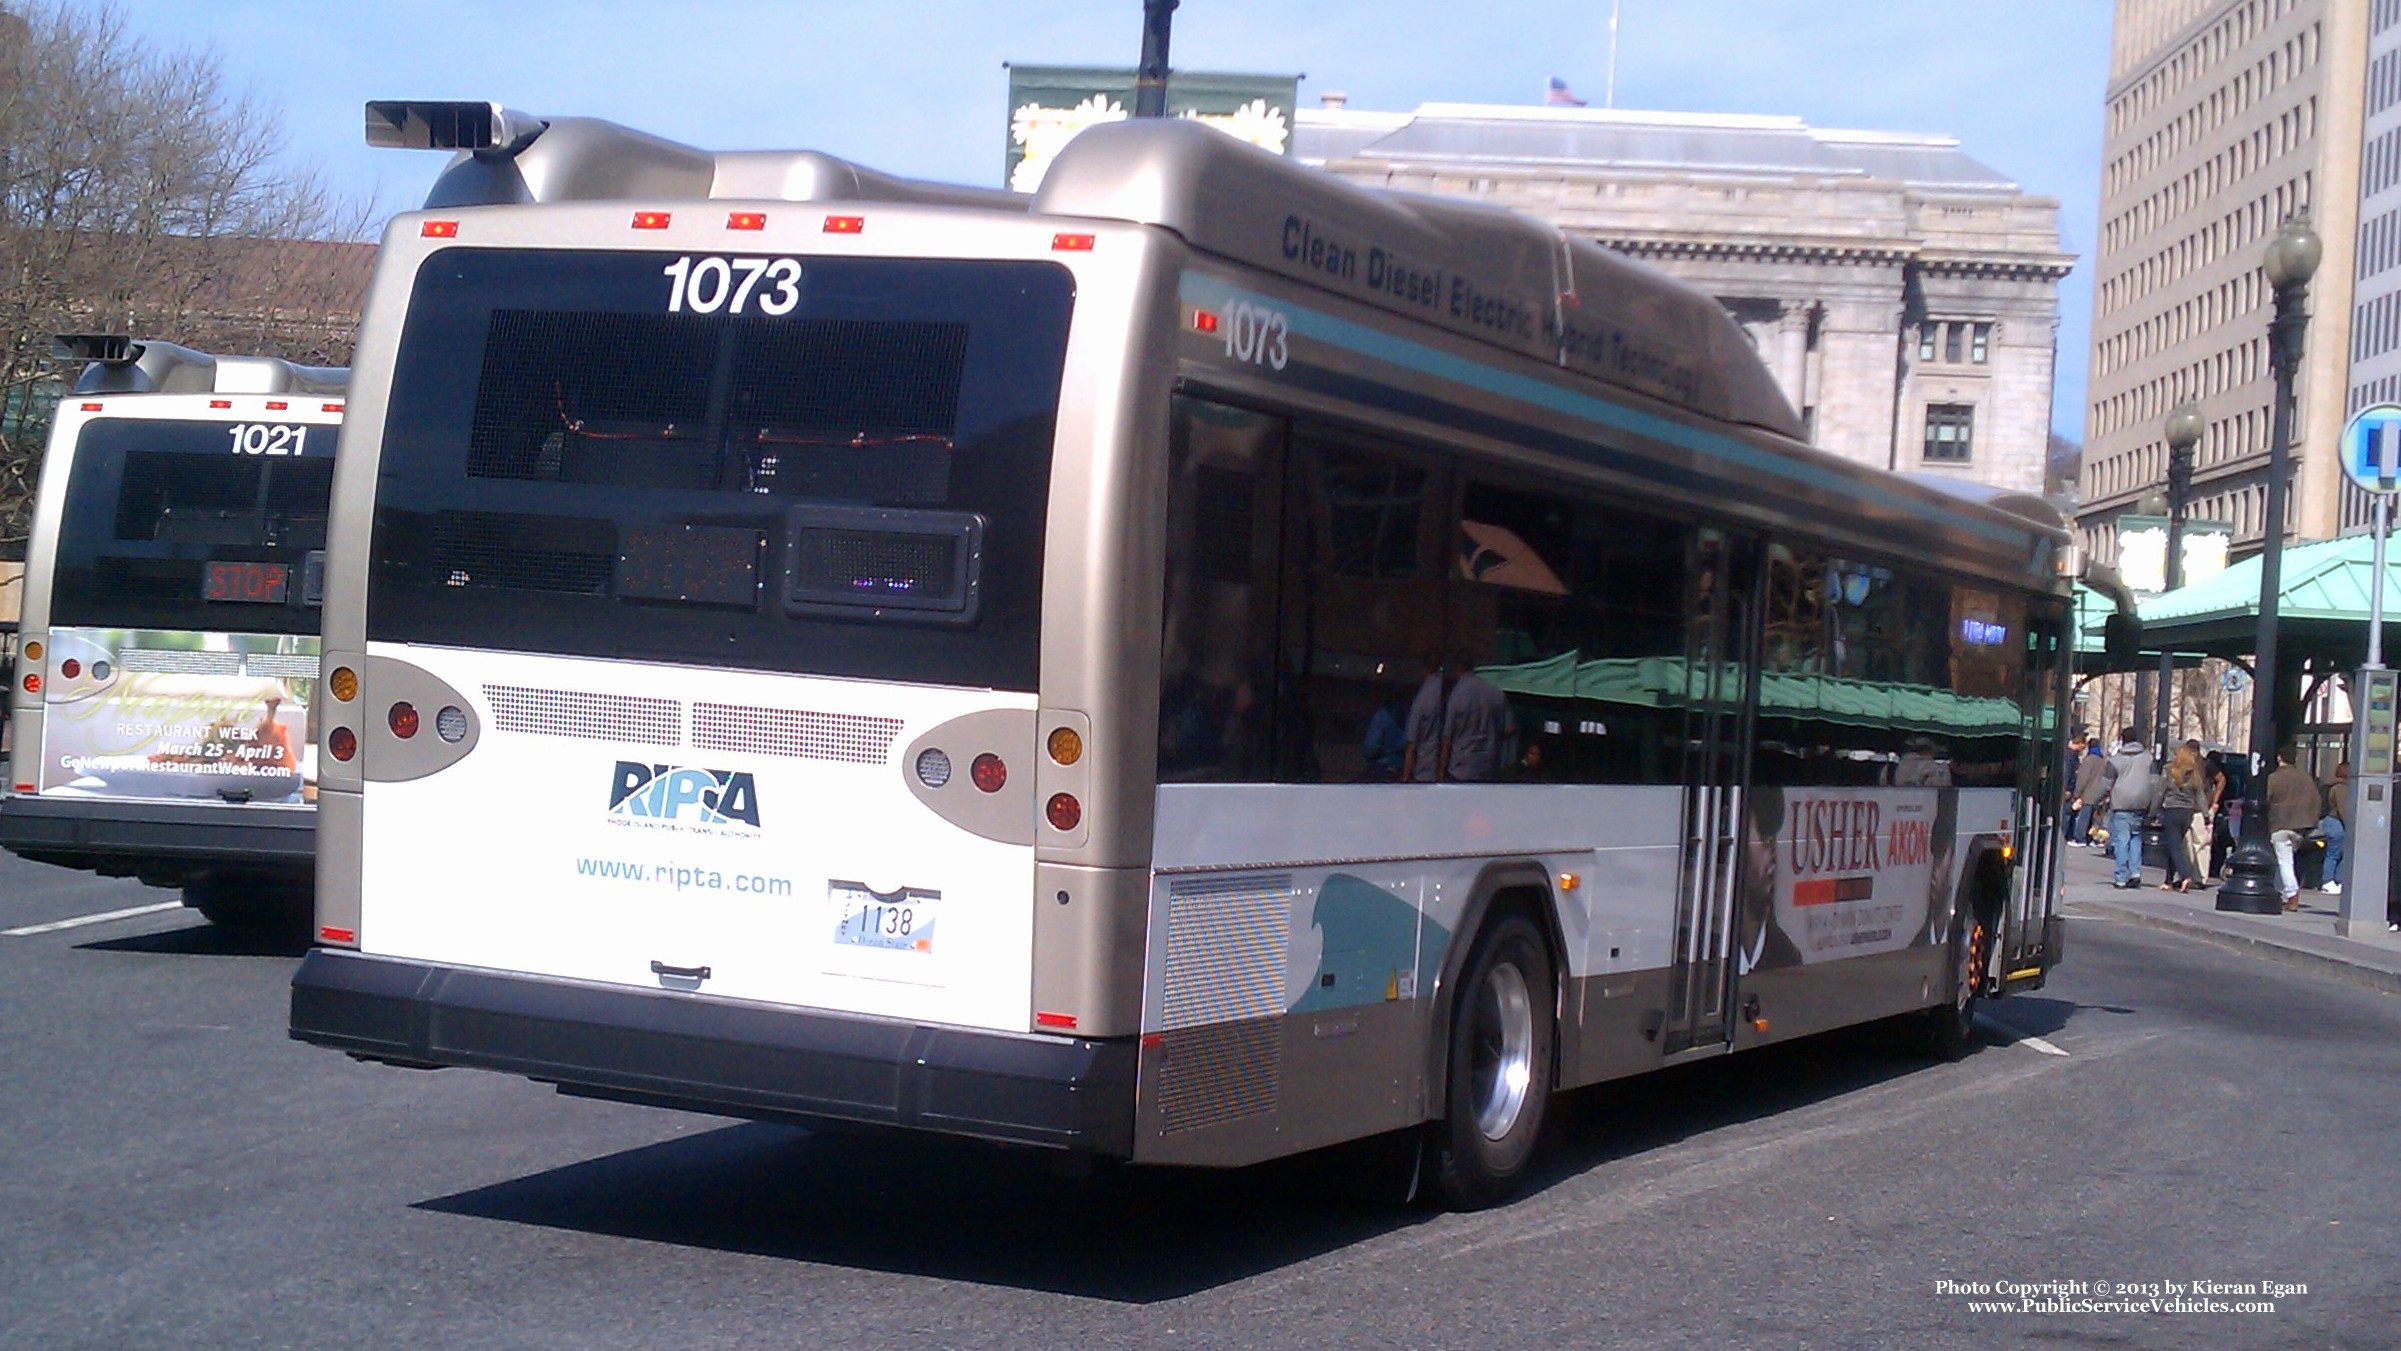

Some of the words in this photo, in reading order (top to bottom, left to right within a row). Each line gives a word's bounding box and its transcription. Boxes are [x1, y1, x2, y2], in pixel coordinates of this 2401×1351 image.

[663, 256, 802, 316] 1073
[1282, 214, 1356, 278] Clean
[1367, 246, 1441, 309] Diesel
[1451, 276, 1537, 341] Electric
[1222, 299, 1289, 371] 1073
[229, 424, 307, 456] 1021
[211, 565, 284, 602] STOP
[117, 722, 212, 739] RESTAURANT
[218, 726, 259, 742] WEEK
[156, 741, 202, 757] March
[204, 743, 224, 757] 25
[235, 744, 271, 761] April
[274, 747, 284, 760] 3
[60, 754, 292, 778] GoNewpRestaurantWeek.com
[608, 760, 762, 828] RIPTA
[1790, 799, 1882, 876] USHER
[1886, 819, 1930, 867] AKON
[576, 857, 793, 897] www.ripta.com
[861, 904, 913, 936] 1138
